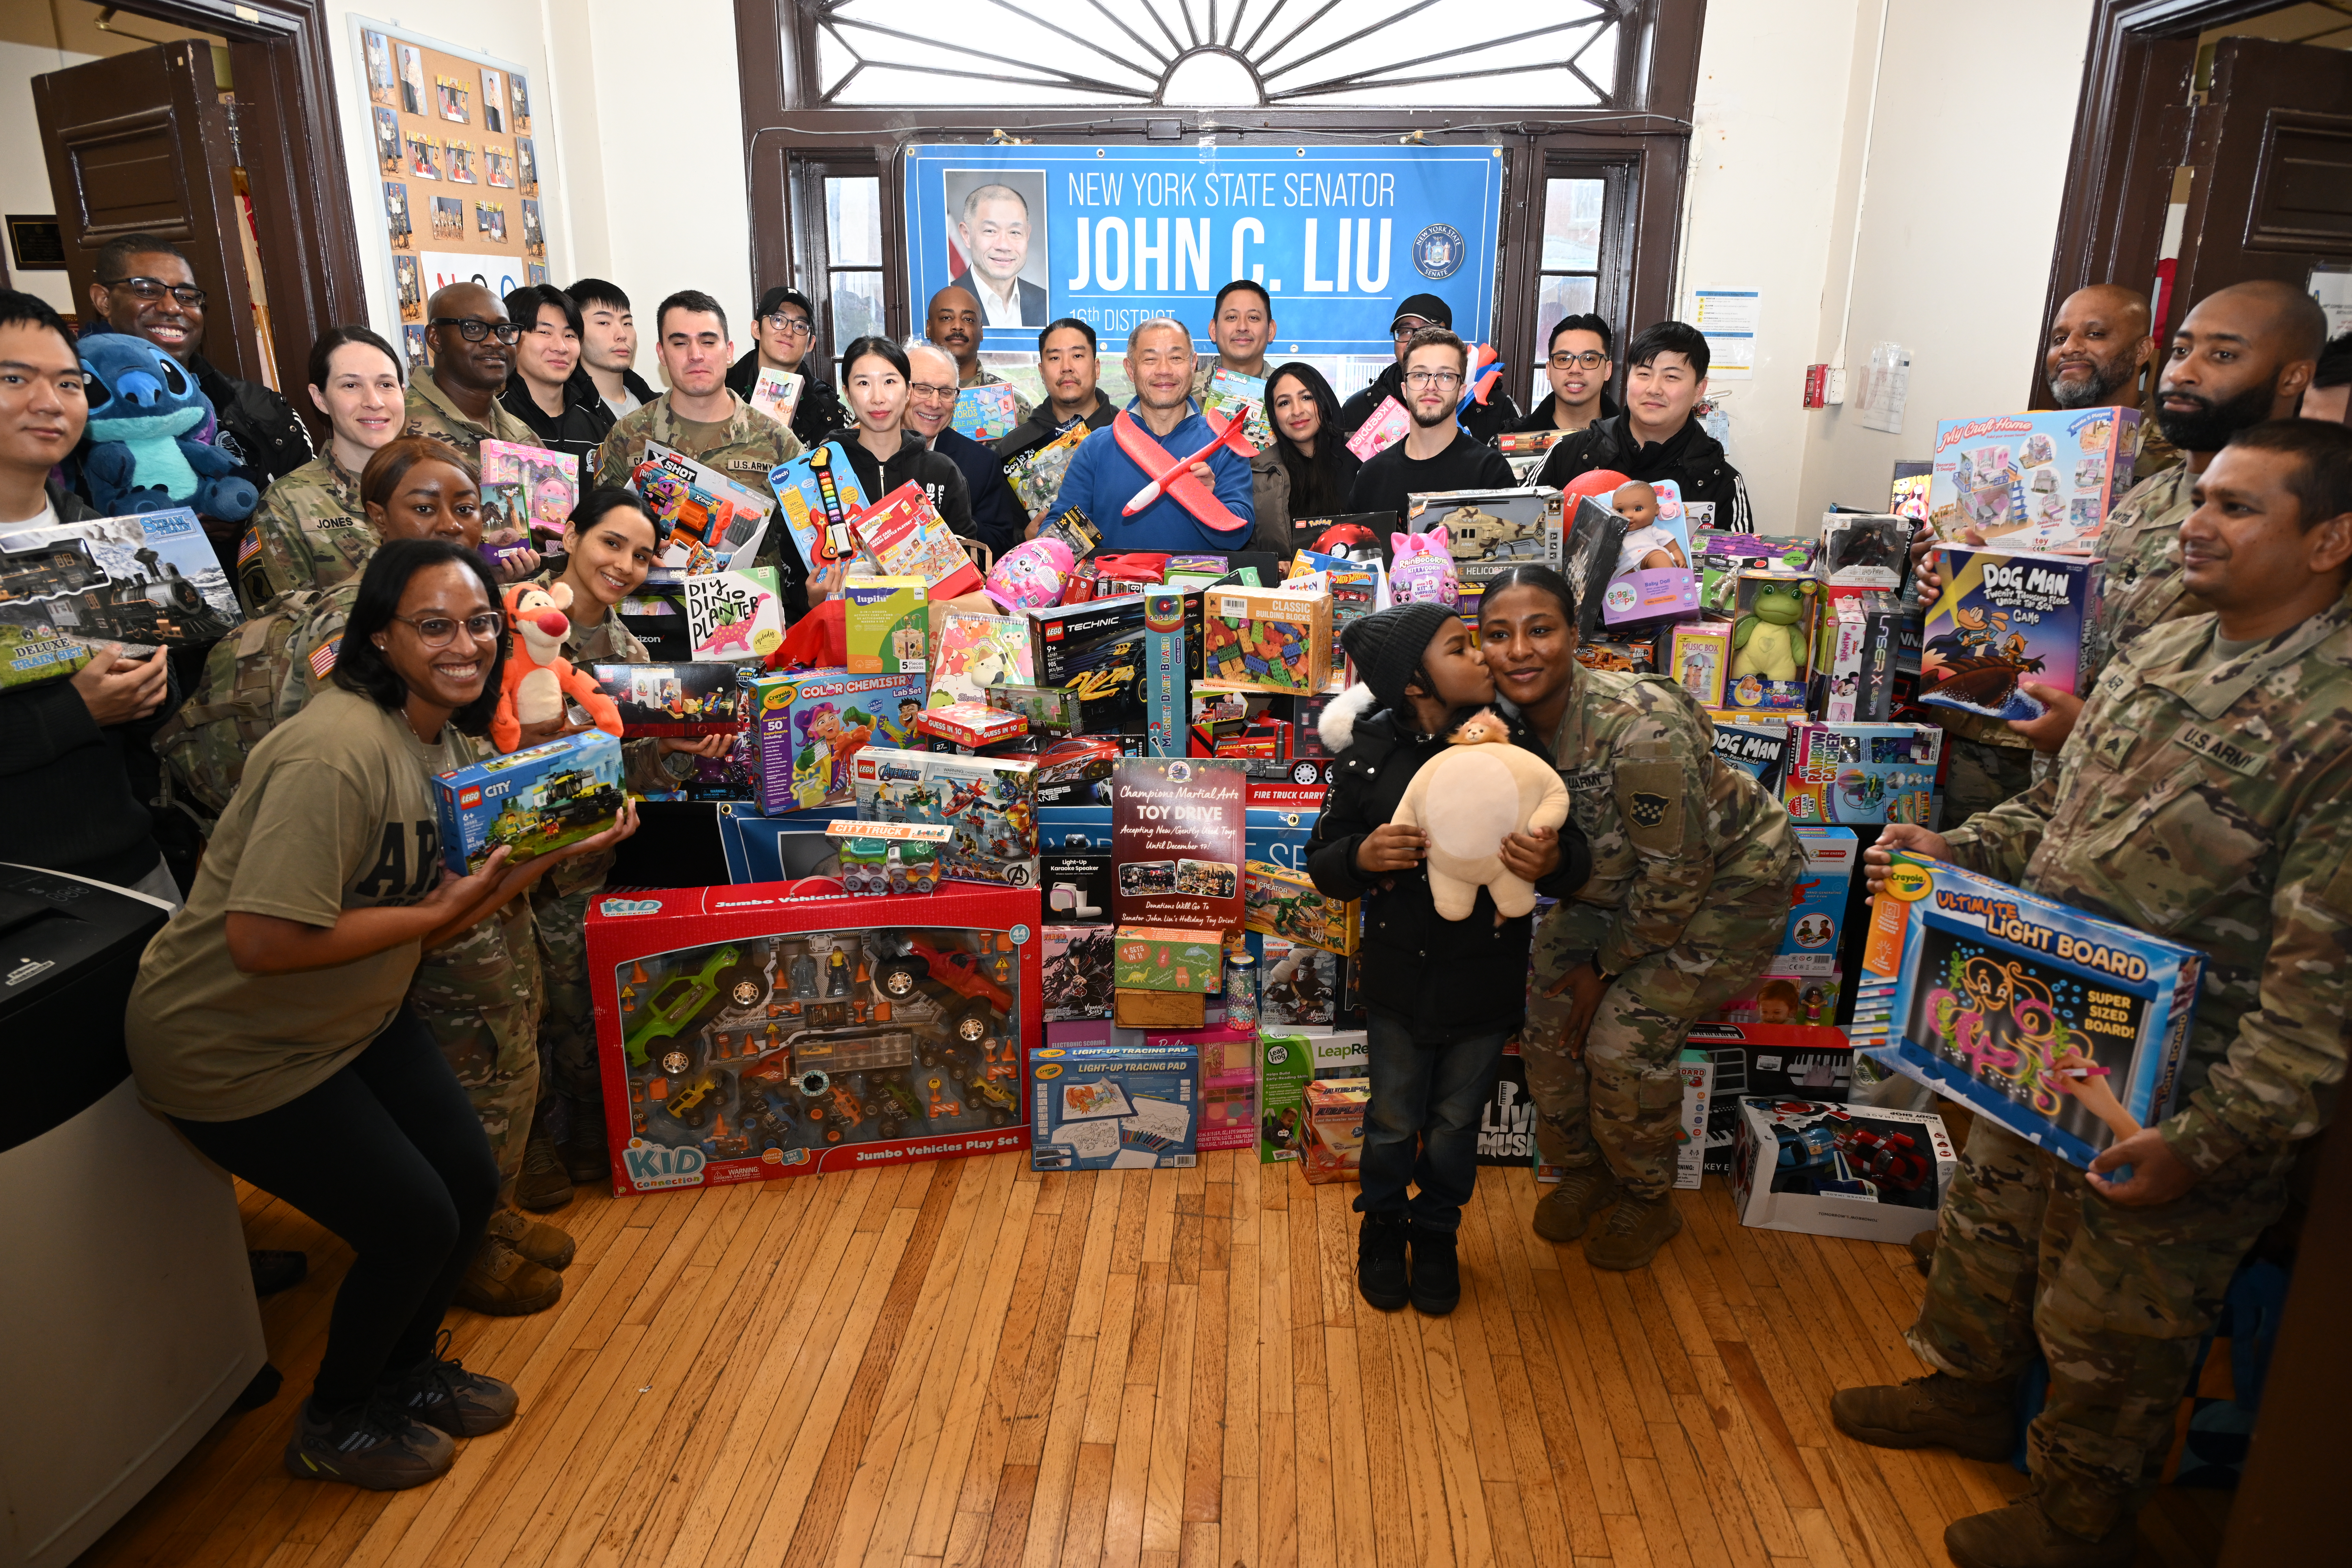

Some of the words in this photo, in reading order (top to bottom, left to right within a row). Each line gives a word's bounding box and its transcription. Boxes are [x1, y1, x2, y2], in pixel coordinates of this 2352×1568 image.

[1069, 173, 1123, 205] NEW
[1133, 173, 1197, 206] YORK
[1205, 173, 1275, 207] STATE
[1284, 174, 1394, 207] SENATOR
[1416, 231, 1427, 245] NEW
[1448, 229, 1461, 246] STATE
[1069, 217, 1210, 291] JOHN
[1231, 217, 1281, 291] C.
[1304, 218, 1392, 293] LIU
[1937, 426, 1964, 453] My
[1964, 418, 1996, 436] Craft
[1995, 417, 2032, 431] Home
[752, 462, 773, 471] ARMY
[771, 470, 789, 481] vtech
[316, 517, 353, 528] JONES
[870, 535, 882, 545] CARRY
[882, 529, 891, 538] CASE
[872, 539, 884, 548] BEACH
[884, 531, 897, 541] BATTLE
[887, 550, 899, 559] AREAS!
[1408, 565, 1440, 574] KITTYCORN
[689, 579, 728, 597] DIY
[1982, 564, 2023, 590] DOG
[2026, 568, 2069, 596] MAN
[690, 590, 745, 619] DINO
[1272, 601, 1310, 613] CLASSIC
[693, 596, 759, 650] PLANTER
[1256, 610, 1284, 619] BUILDING
[1286, 613, 1310, 621] BLOCKS
[1046, 627, 1063, 637] LEGO
[1067, 617, 1119, 632] TECHNIC
[15, 638, 70, 658] DELUXE
[1160, 637, 1170, 671] BOARD
[1682, 643, 1703, 651] MUSIC
[1704, 643, 1718, 652] BOX
[10, 651, 55, 671] TRAIN
[56, 646, 84, 661] SET
[801, 683, 844, 699] COLOR
[847, 674, 915, 692] CHEMISTRY
[1161, 676, 1170, 700] DART
[1870, 675, 1883, 685] X
[768, 689, 790, 701] Crayola
[768, 721, 783, 731] 50
[929, 720, 946, 730] GUESS
[1162, 705, 1171, 748] MAGNET
[983, 730, 1001, 738] GUESS
[1808, 732, 1826, 782] RAINBOW
[1822, 733, 1841, 782] CATCHER
[858, 765, 874, 773] LEGO
[879, 763, 921, 781] AVENGERS
[461, 791, 480, 803] LEGO
[485, 780, 511, 797] CITY
[1120, 786, 1174, 803] Champions
[1175, 787, 1216, 799] Martial
[1216, 788, 1238, 800] Arts
[1137, 806, 1170, 819] TOY
[1175, 807, 1222, 820] DRIVE
[866, 827, 903, 835] TRUCK
[1120, 825, 1154, 837] Accepting
[1222, 826, 1236, 838] Toys
[1167, 842, 1198, 850] December
[1890, 872, 1924, 884] Crayola
[1259, 882, 1288, 895] CREATOR
[1146, 901, 1174, 910] Donations
[1176, 902, 1191, 910] Will
[1179, 915, 1203, 923] Holiday
[1207, 916, 1216, 924] Toy
[1987, 918, 2052, 950] LIGHT
[2057, 934, 2148, 981] BOARD
[2087, 991, 2131, 1009] SUPER
[2090, 1006, 2128, 1023] SIZED
[2084, 1019, 2135, 1039] BOARD!
[1269, 1048, 1284, 1056] Leap
[1271, 1053, 1286, 1062] Frog
[1078, 1063, 1123, 1072] LIGHT-UP
[1125, 1063, 1165, 1071] TRACING
[1167, 1062, 1187, 1071] PAD
[856, 1150, 903, 1163] Jumbo
[906, 1143, 962, 1157] Vehicles
[966, 1139, 995, 1154] Play
[996, 1136, 1019, 1148] Set
[626, 1149, 702, 1179] KID
[728, 1167, 759, 1175] WARNING:
[636, 1176, 700, 1189] Connection
